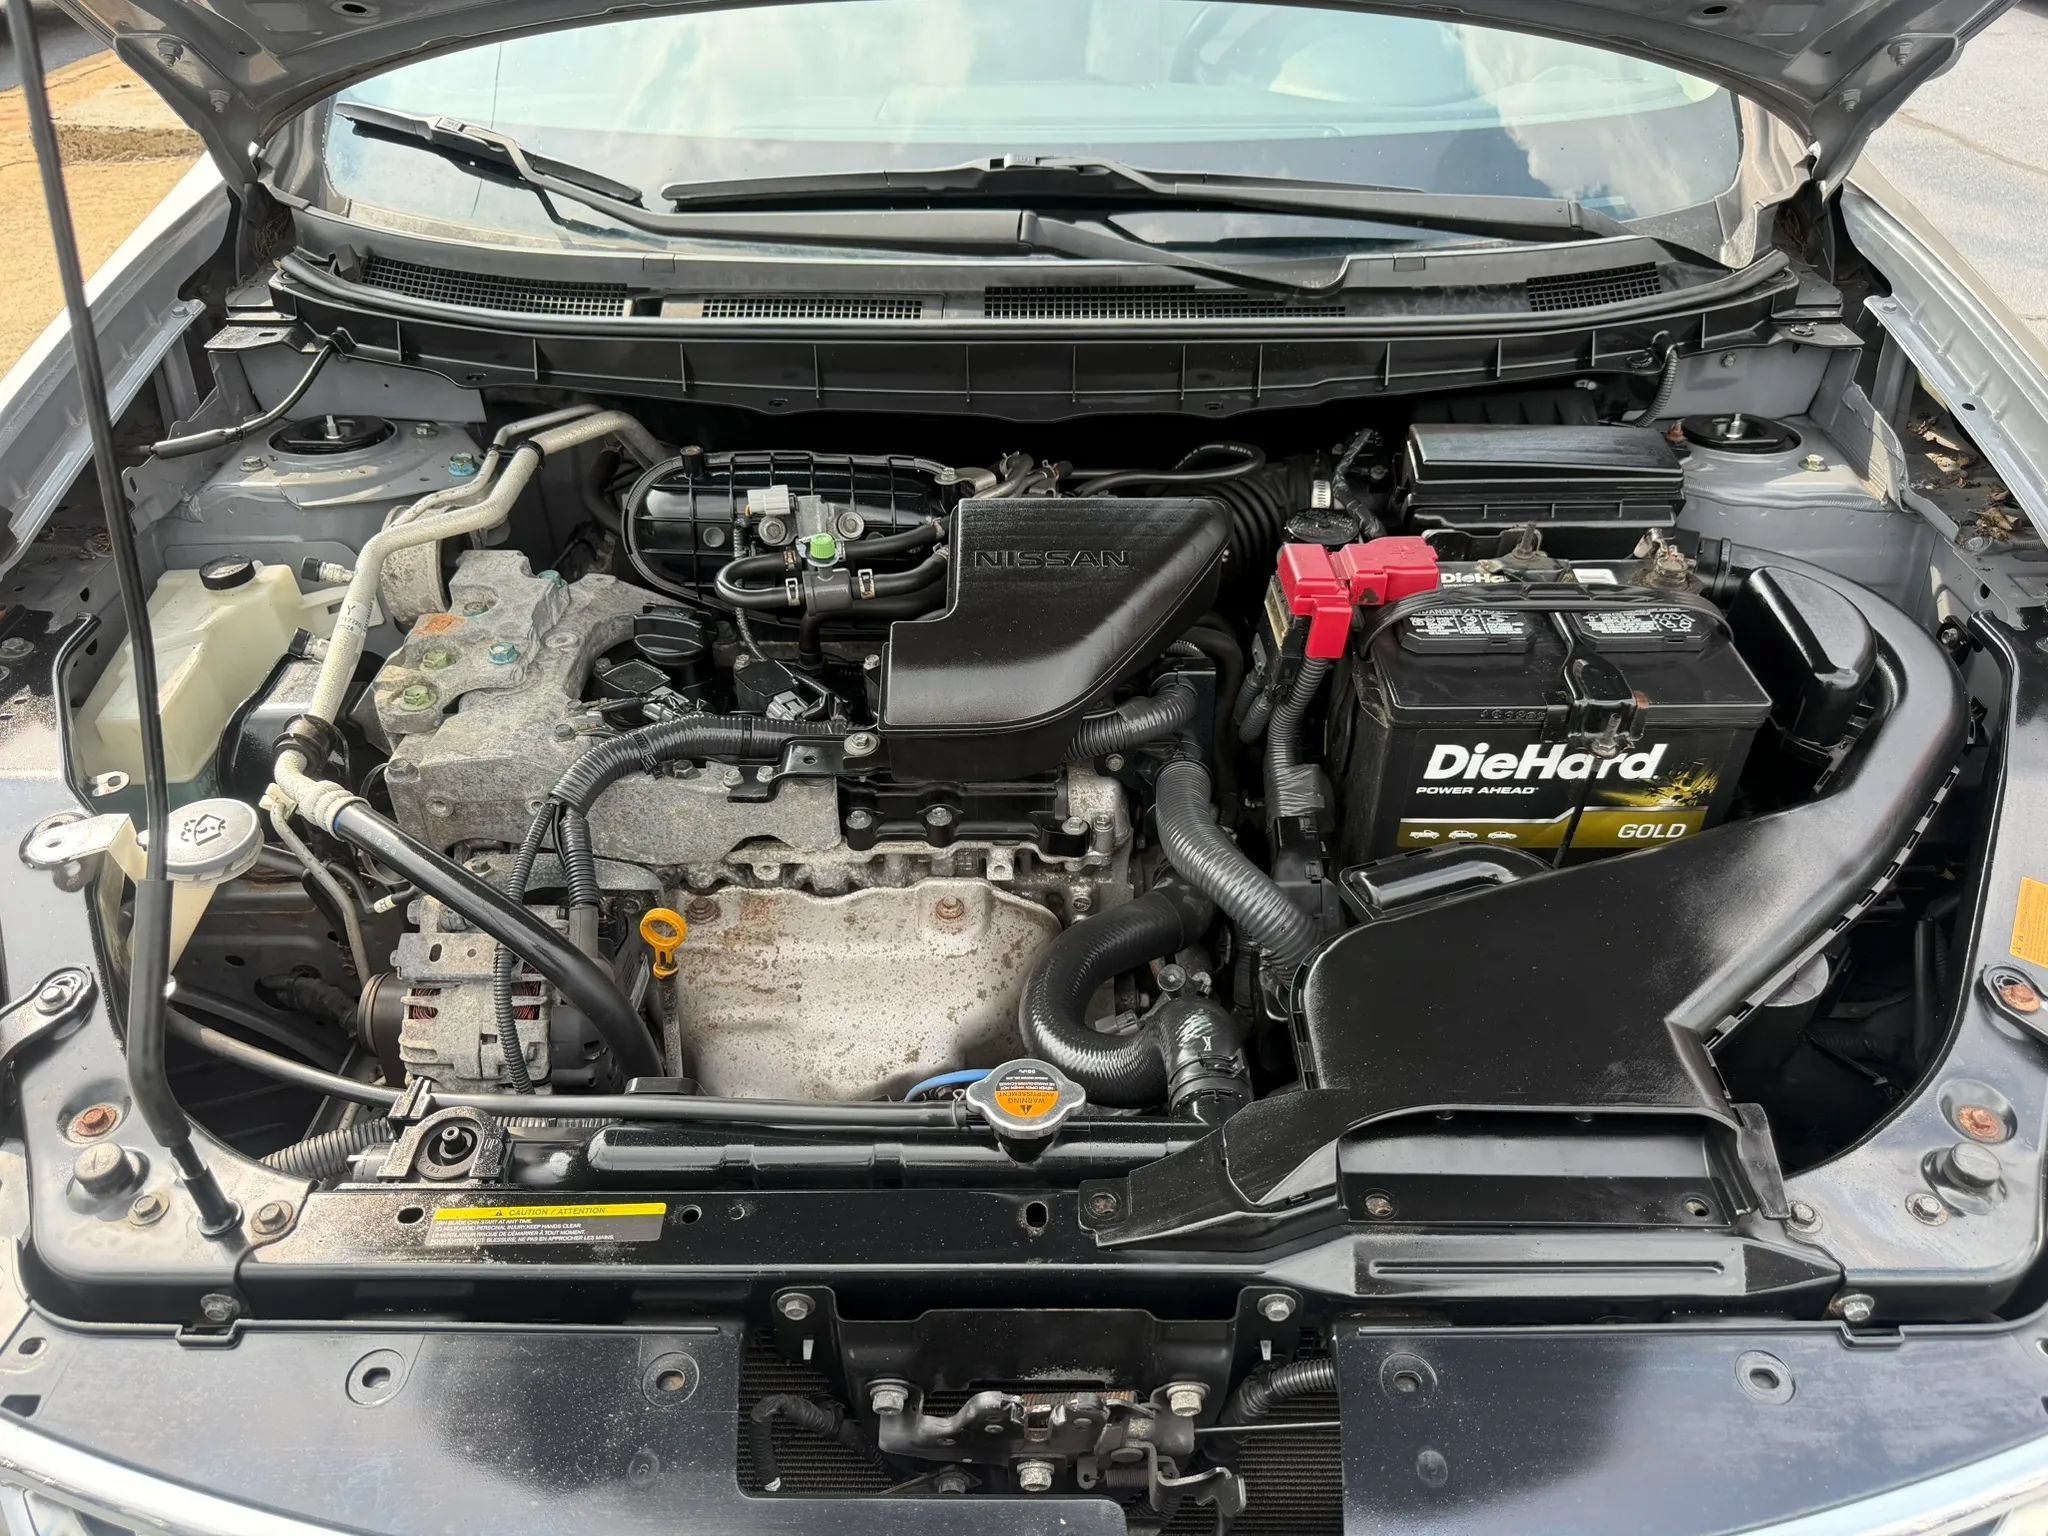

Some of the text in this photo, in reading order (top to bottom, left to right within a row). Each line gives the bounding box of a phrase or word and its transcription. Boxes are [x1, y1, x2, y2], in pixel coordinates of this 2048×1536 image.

[974, 550, 1129, 568] NISSAN
[1423, 742, 1669, 781] DieHard
[1415, 786, 1535, 795] POWER AHEAD
[1617, 823, 1686, 840] GOLD
[484, 1138, 499, 1150] UP
[557, 1207, 606, 1215] ATTENTION
